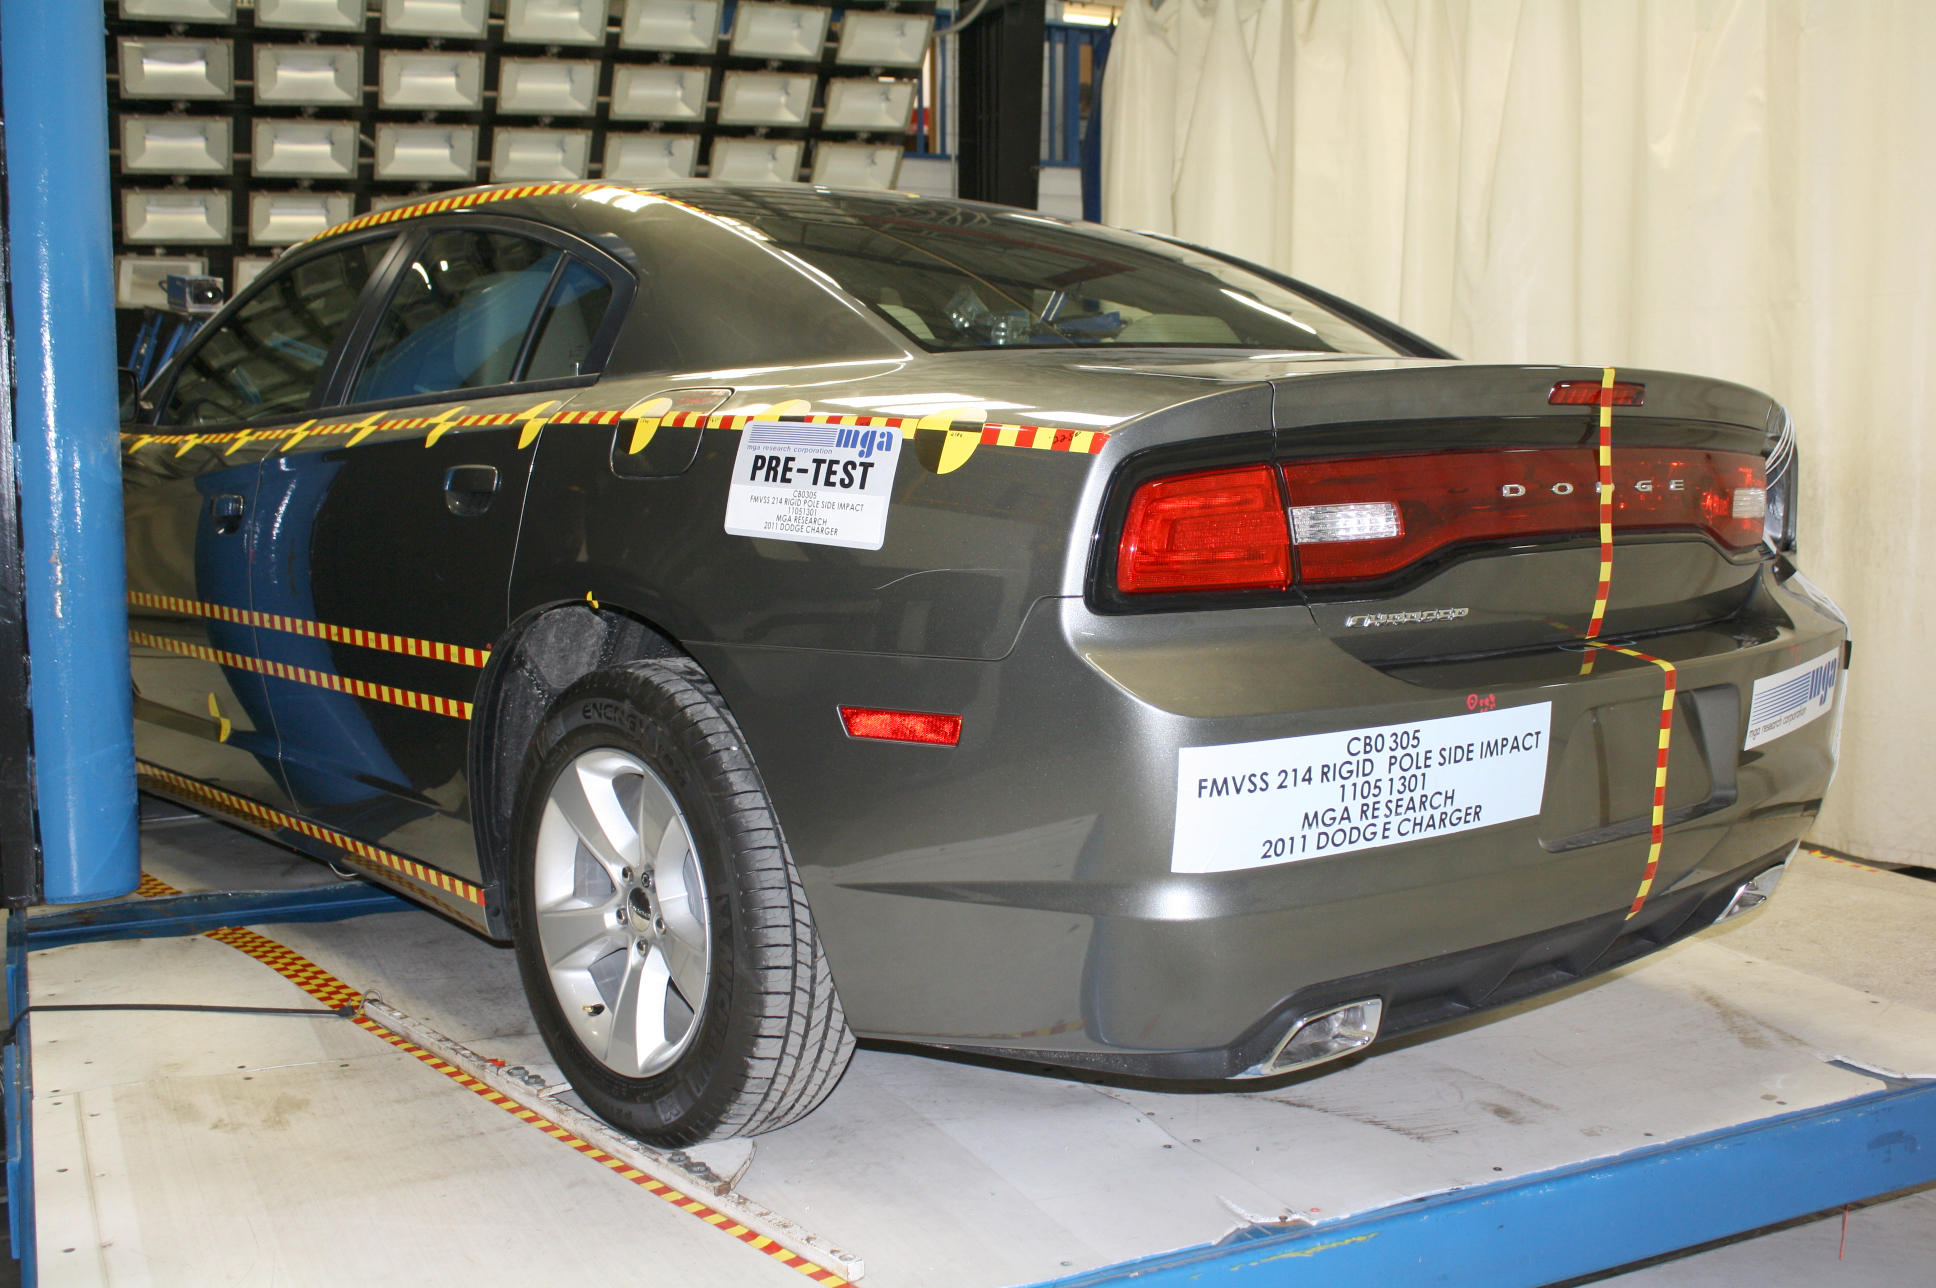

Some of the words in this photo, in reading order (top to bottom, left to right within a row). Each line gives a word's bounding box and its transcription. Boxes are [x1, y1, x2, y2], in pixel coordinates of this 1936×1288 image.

[763, 445, 791, 453] research
[794, 447, 832, 455] corporation
[835, 428, 893, 458] mga
[750, 455, 874, 490] PRE-TEST
[750, 495, 770, 504] FMVSS
[772, 496, 782, 505] 214
[784, 498, 802, 507] RIGID
[804, 499, 819, 508] POLE
[821, 501, 836, 510] SIDE
[837, 502, 864, 512] IMPACT
[793, 490, 817, 499] CB0305
[776, 514, 792, 523] MGA
[793, 516, 827, 526] RESEARCH
[788, 507, 817, 516] 11051301
[764, 522, 778, 530] 2011
[780, 523, 804, 533] DODGE
[805, 525, 838, 536] CHARGER
[1748, 727, 1761, 741] mga
[1762, 716, 1782, 734] research
[1782, 706, 1806, 726] corporation
[1198, 771, 1269, 798] FMVSS
[1276, 766, 1312, 790] 214
[1320, 758, 1374, 784] RIGID
[1388, 749, 1432, 774] POLE
[1438, 743, 1474, 768] SIDE
[1479, 731, 1542, 759] IMPACT
[1301, 806, 1351, 831] MGA
[1360, 789, 1455, 820] RESEARCH
[1260, 835, 1307, 859] 2011
[1316, 820, 1390, 851] DODGE
[1397, 804, 1482, 837] CHARGER
